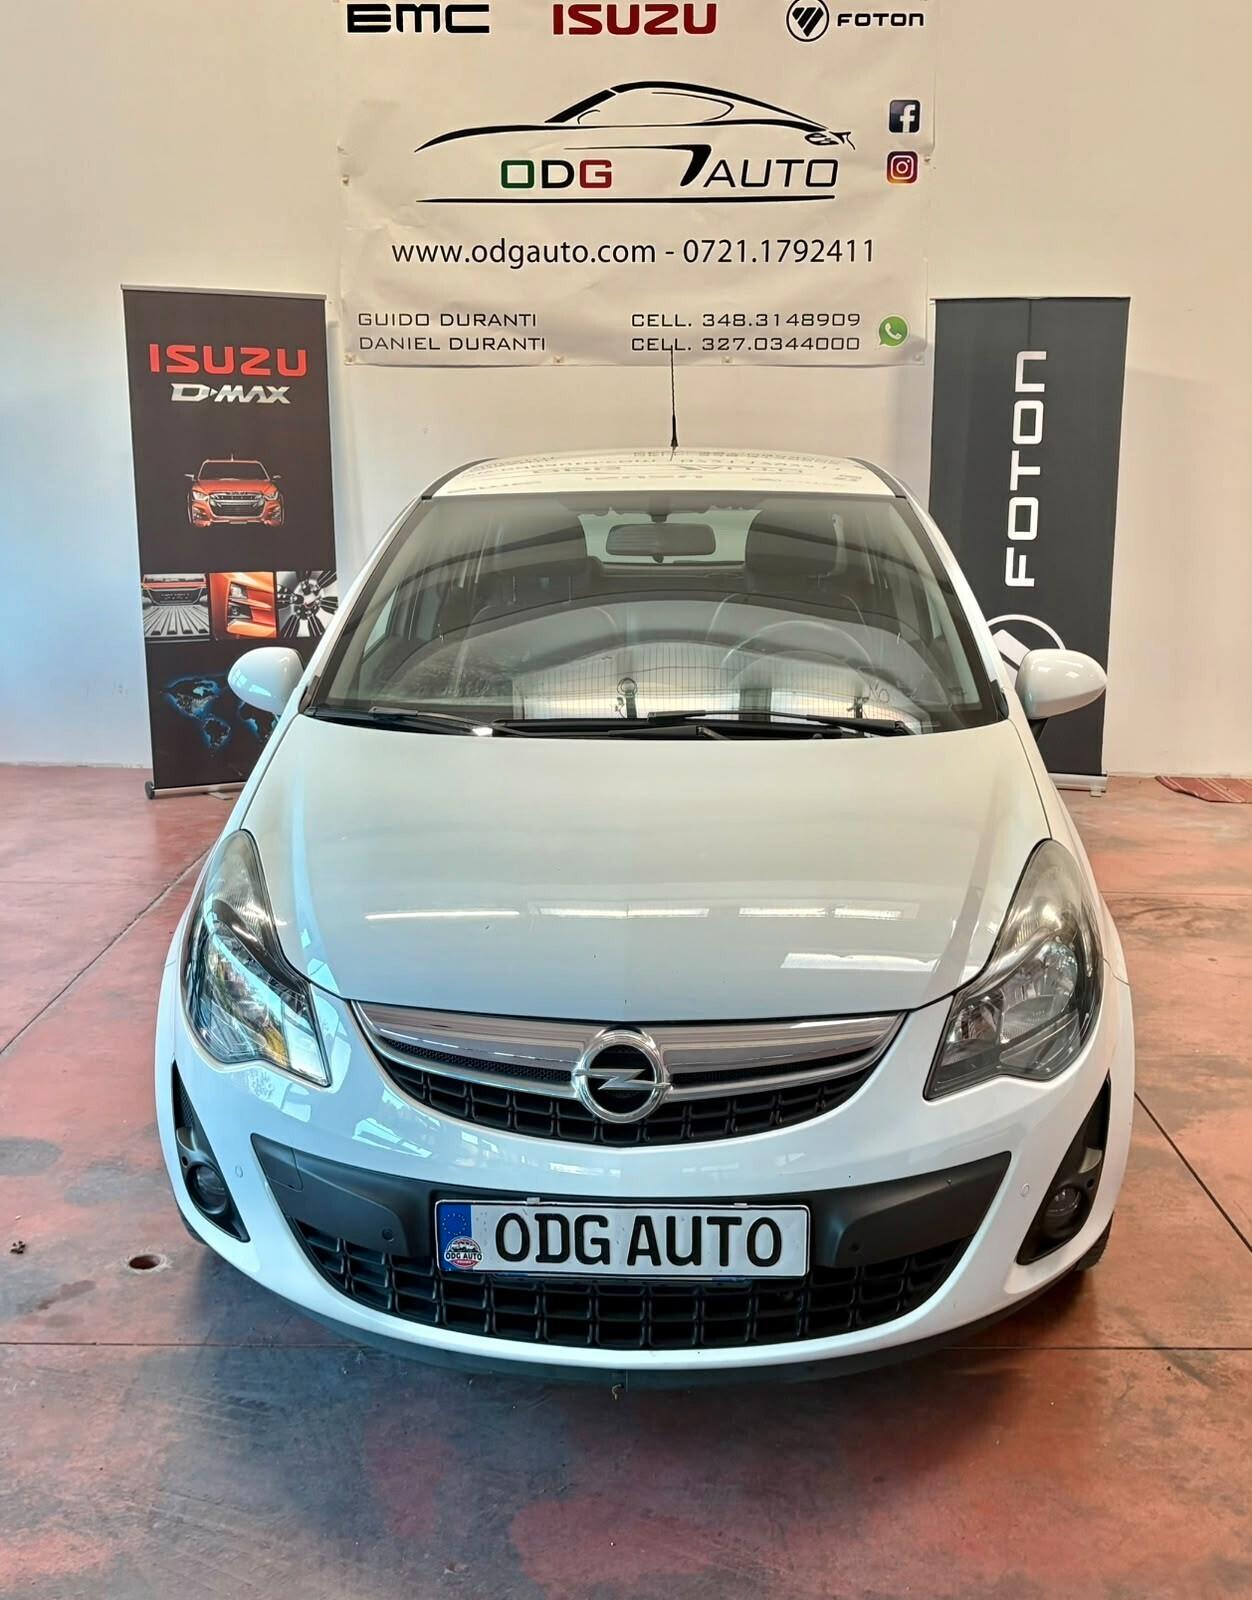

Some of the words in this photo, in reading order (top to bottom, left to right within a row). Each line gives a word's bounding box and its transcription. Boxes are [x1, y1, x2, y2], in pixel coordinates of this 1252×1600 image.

[347, 4, 489, 33] EMC
[553, 4, 716, 35] ISUZU
[838, 13, 923, 26] FOTON
[501, 160, 611, 188] ODG
[703, 159, 838, 188] AUTO
[392, 238, 655, 269] www.odgauto.com
[684, 239, 871, 262] 0721.1792411
[359, 313, 429, 326] GUIDO
[441, 314, 535, 326] DURANTI
[632, 314, 691, 326] CELL.
[703, 314, 860, 326] 348.3148909
[360, 337, 440, 350] DANIEL
[450, 338, 544, 350] DURANTI
[632, 338, 691, 351] CELL.
[702, 338, 859, 350] 327.0344000
[150, 344, 306, 376] ISUZU
[1005, 351, 1046, 586] FOTON
[496, 1213, 610, 1265] ODG
[627, 1216, 782, 1267] AUTO
[445, 1252, 461, 1260] ODG
[463, 1252, 482, 1261] AUTO
